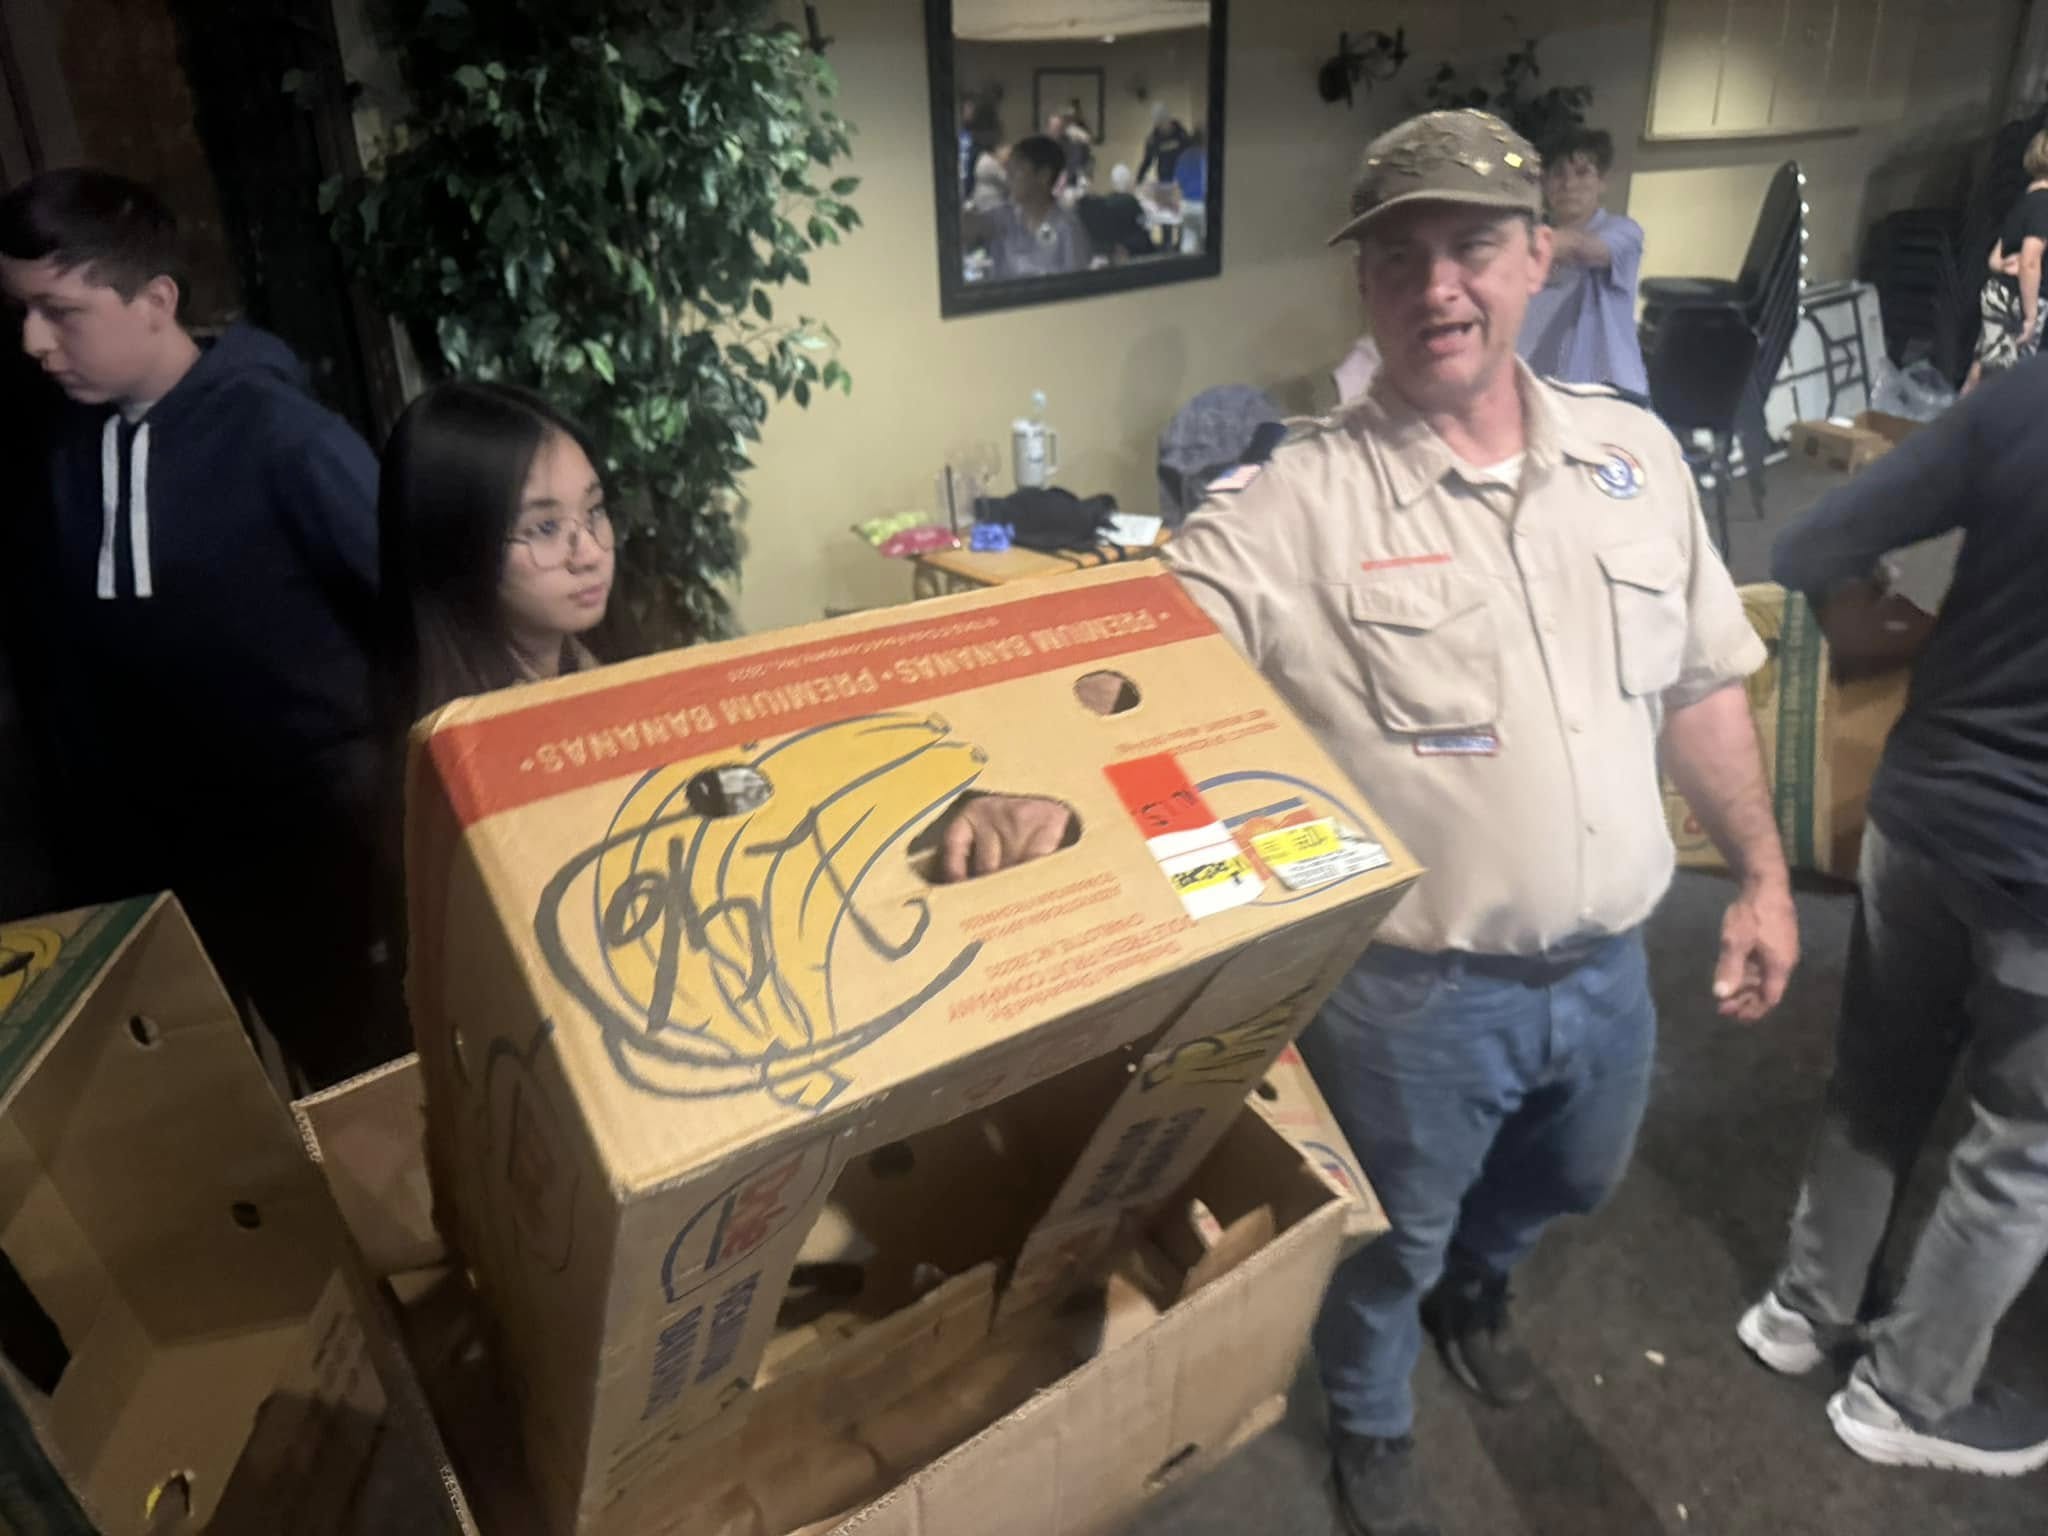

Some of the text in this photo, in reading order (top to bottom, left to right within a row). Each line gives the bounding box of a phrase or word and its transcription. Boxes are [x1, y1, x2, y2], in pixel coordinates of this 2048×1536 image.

[537, 609, 1157, 773] PREMIUM BANANAS PREMIUM BANANAS
